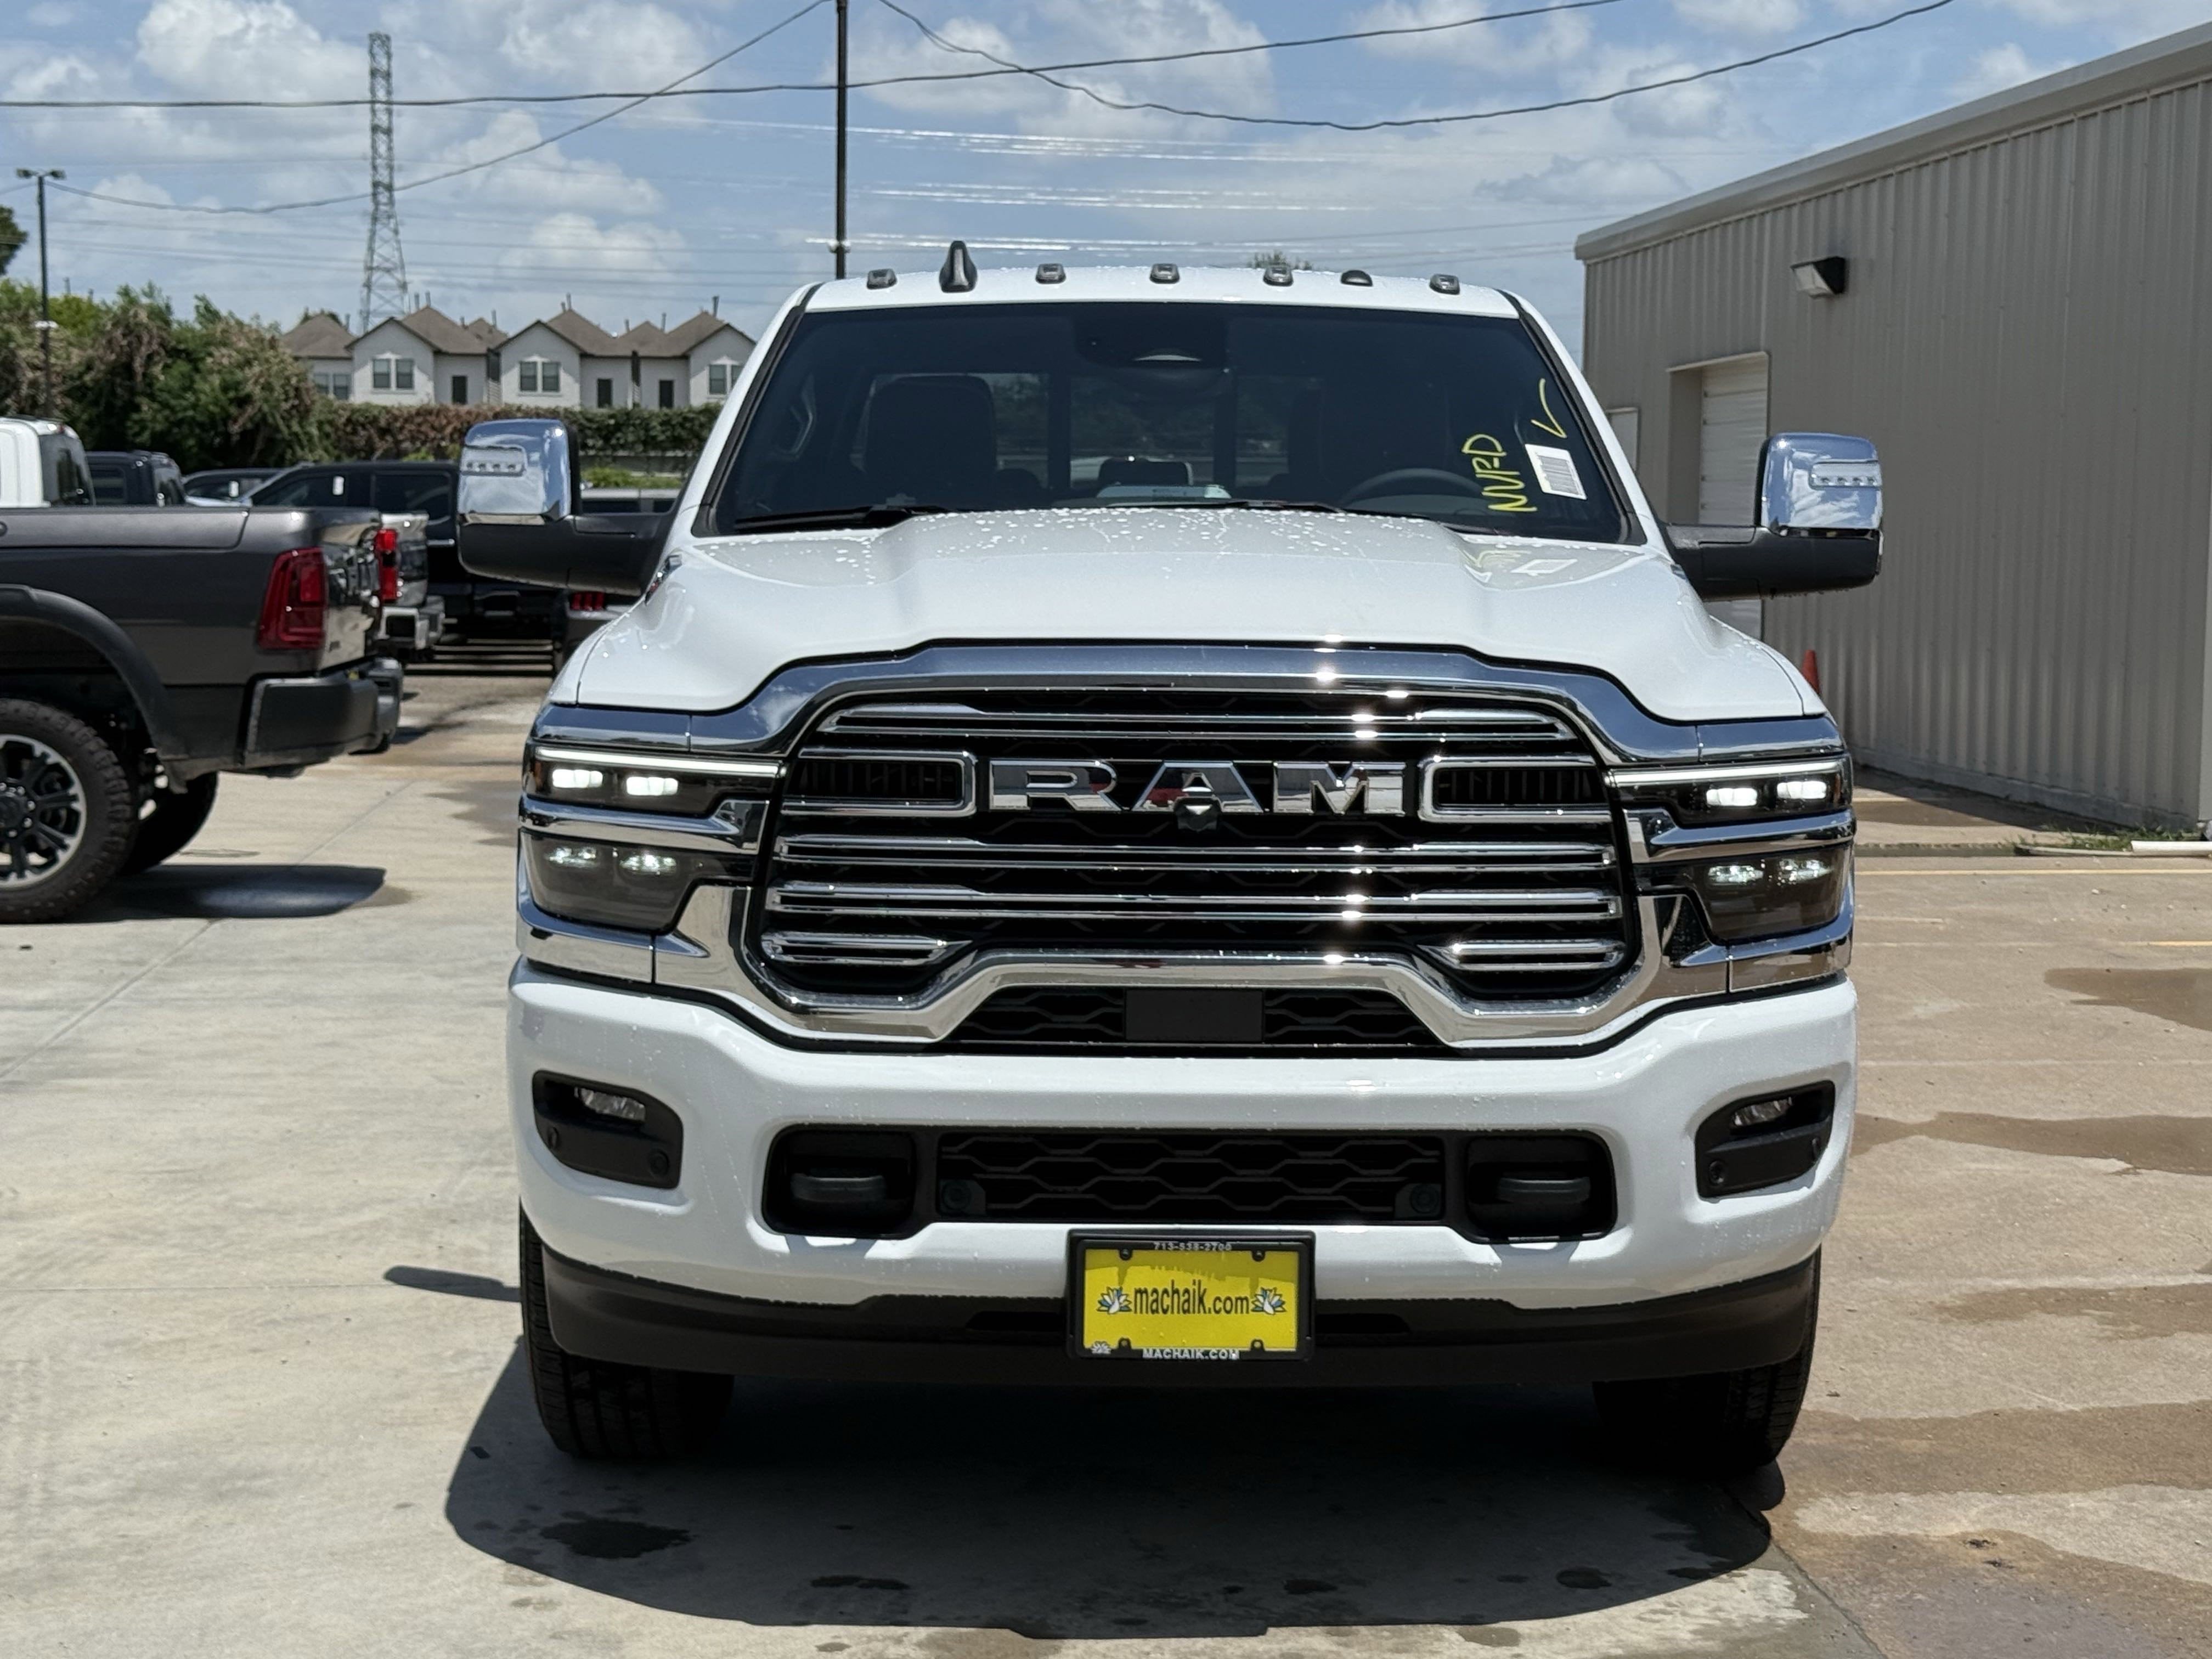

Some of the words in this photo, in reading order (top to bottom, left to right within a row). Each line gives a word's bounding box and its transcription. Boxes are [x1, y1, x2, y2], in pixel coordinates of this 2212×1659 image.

[989, 758, 1406, 815] RAM
[1134, 1279, 1249, 1314] machaik.com
[1143, 1348, 1239, 1360] MACHAIK.COM
